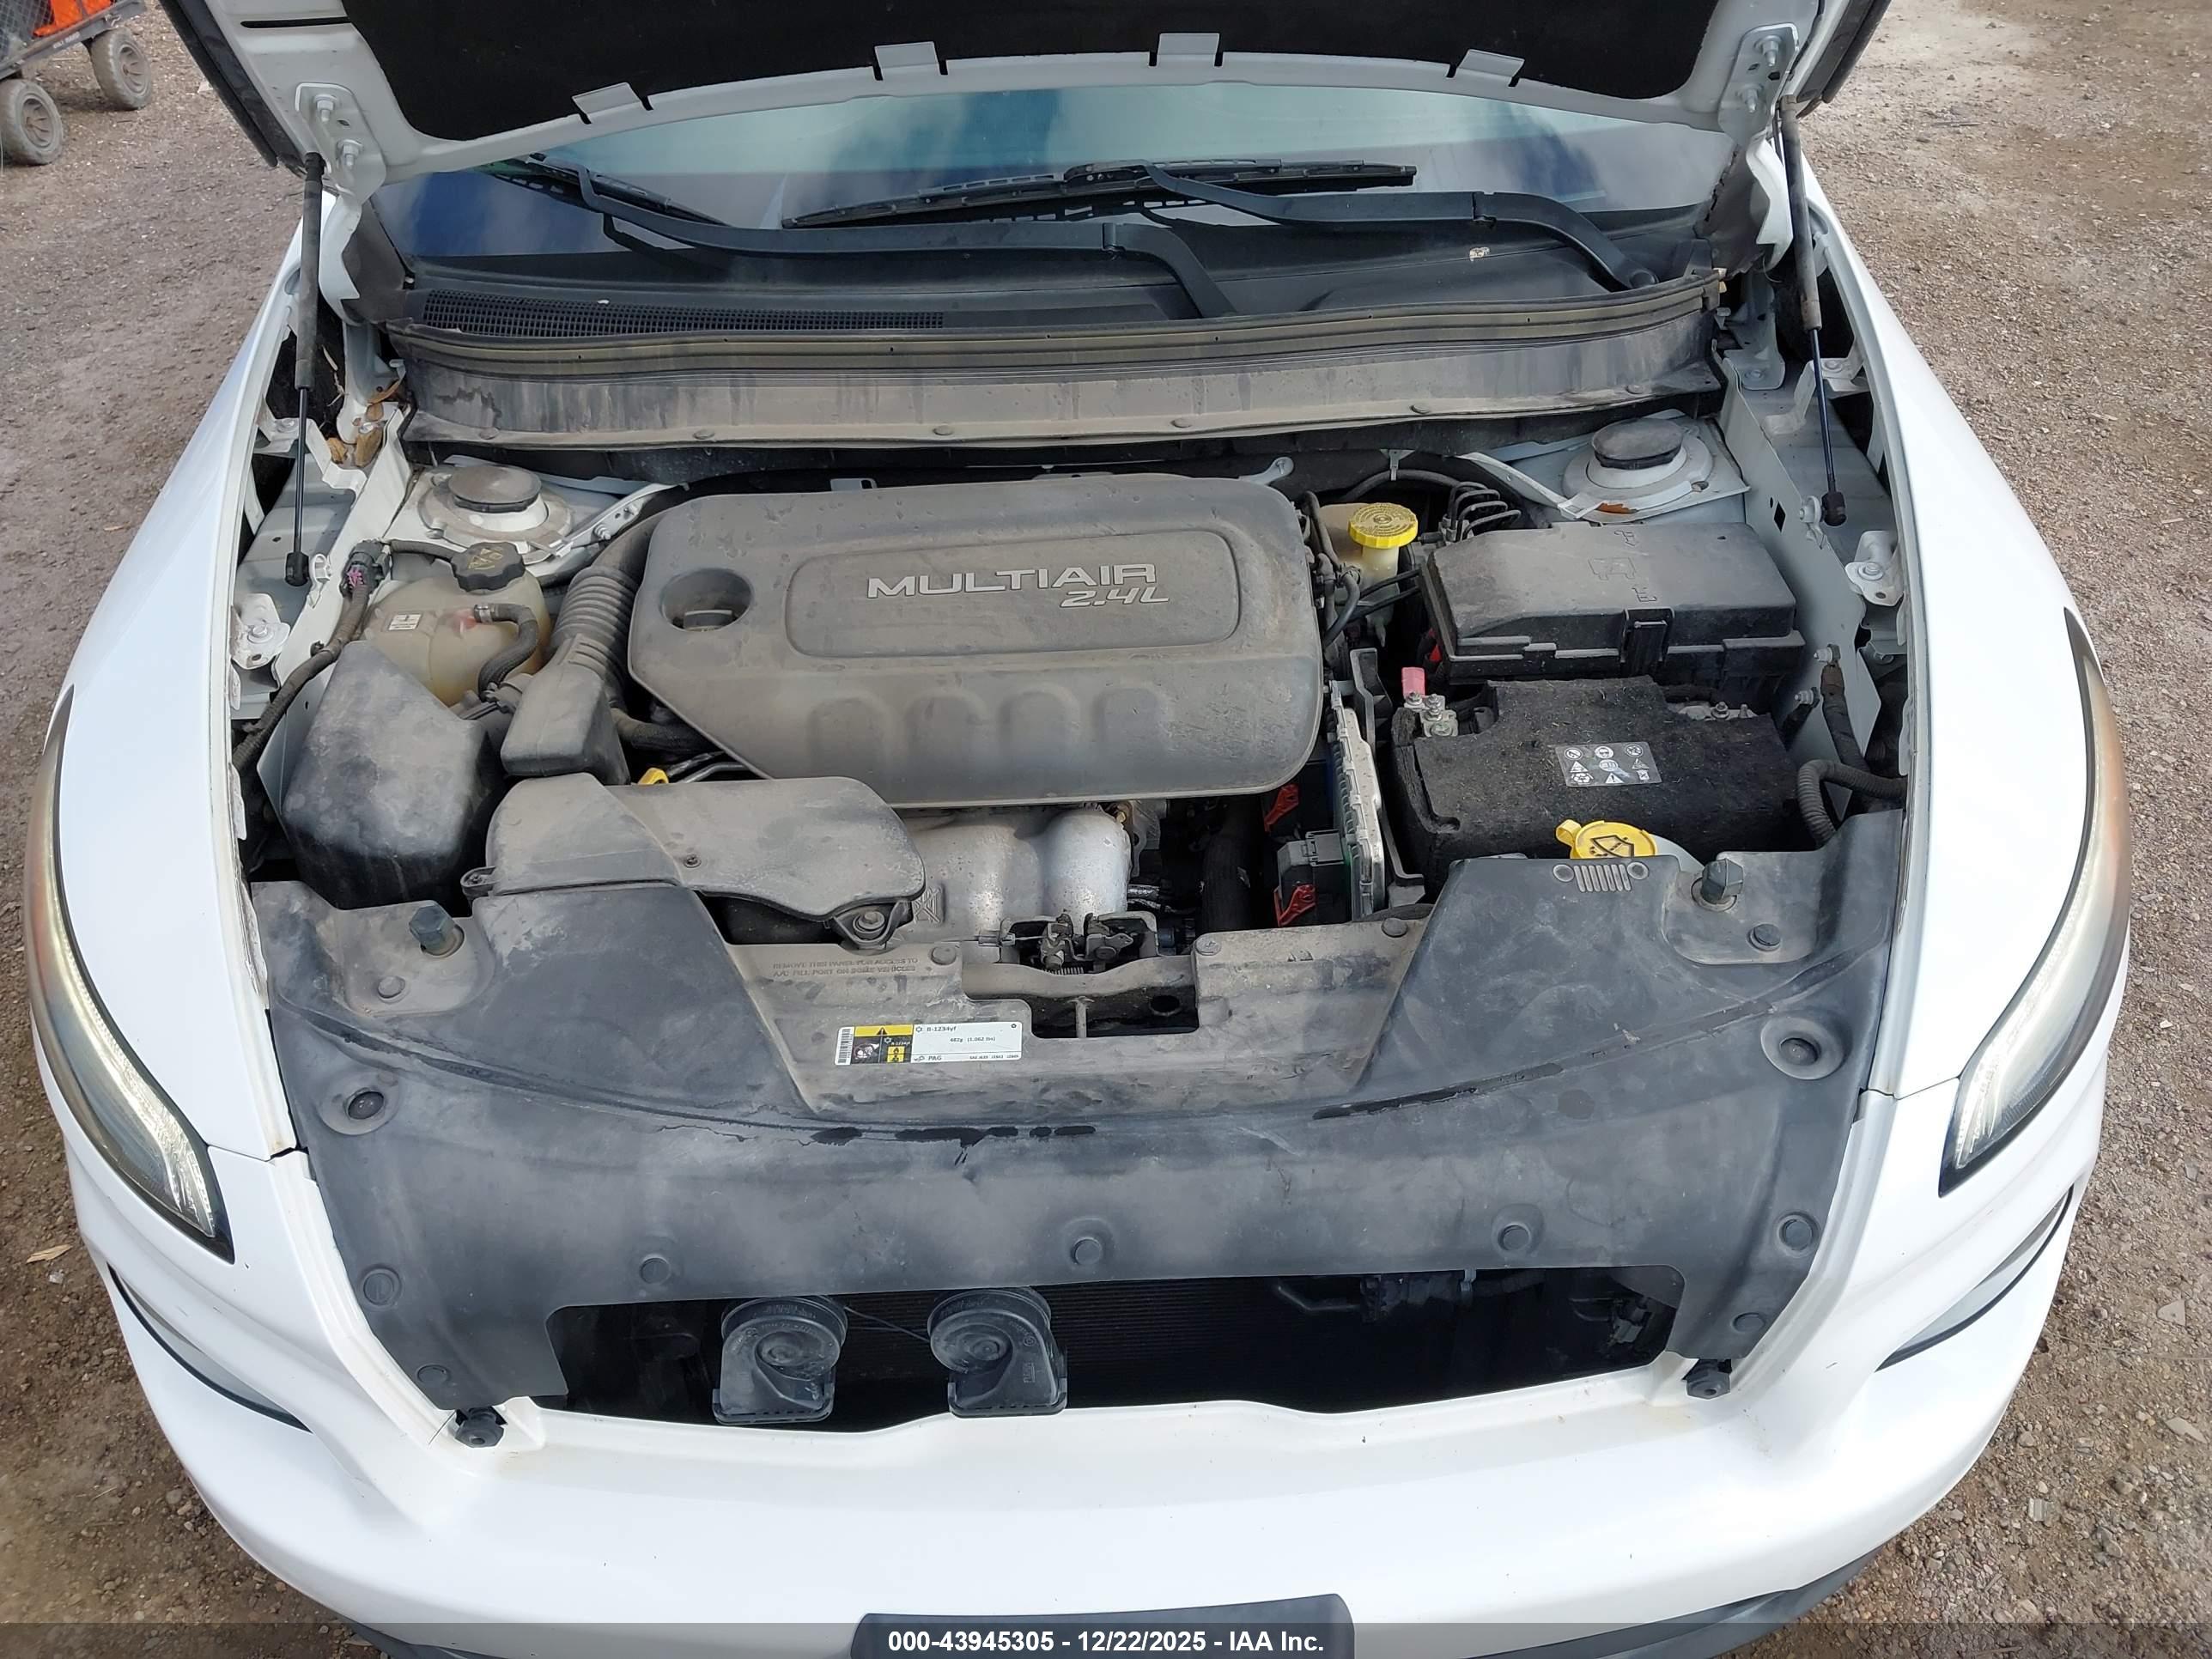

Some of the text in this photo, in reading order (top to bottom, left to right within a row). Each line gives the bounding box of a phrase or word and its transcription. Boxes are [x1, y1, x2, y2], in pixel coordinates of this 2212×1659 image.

[866, 562, 1157, 599] MULTIAIR
[1060, 586, 1170, 609] 2.4L
[773, 961, 805, 969] REMOVE
